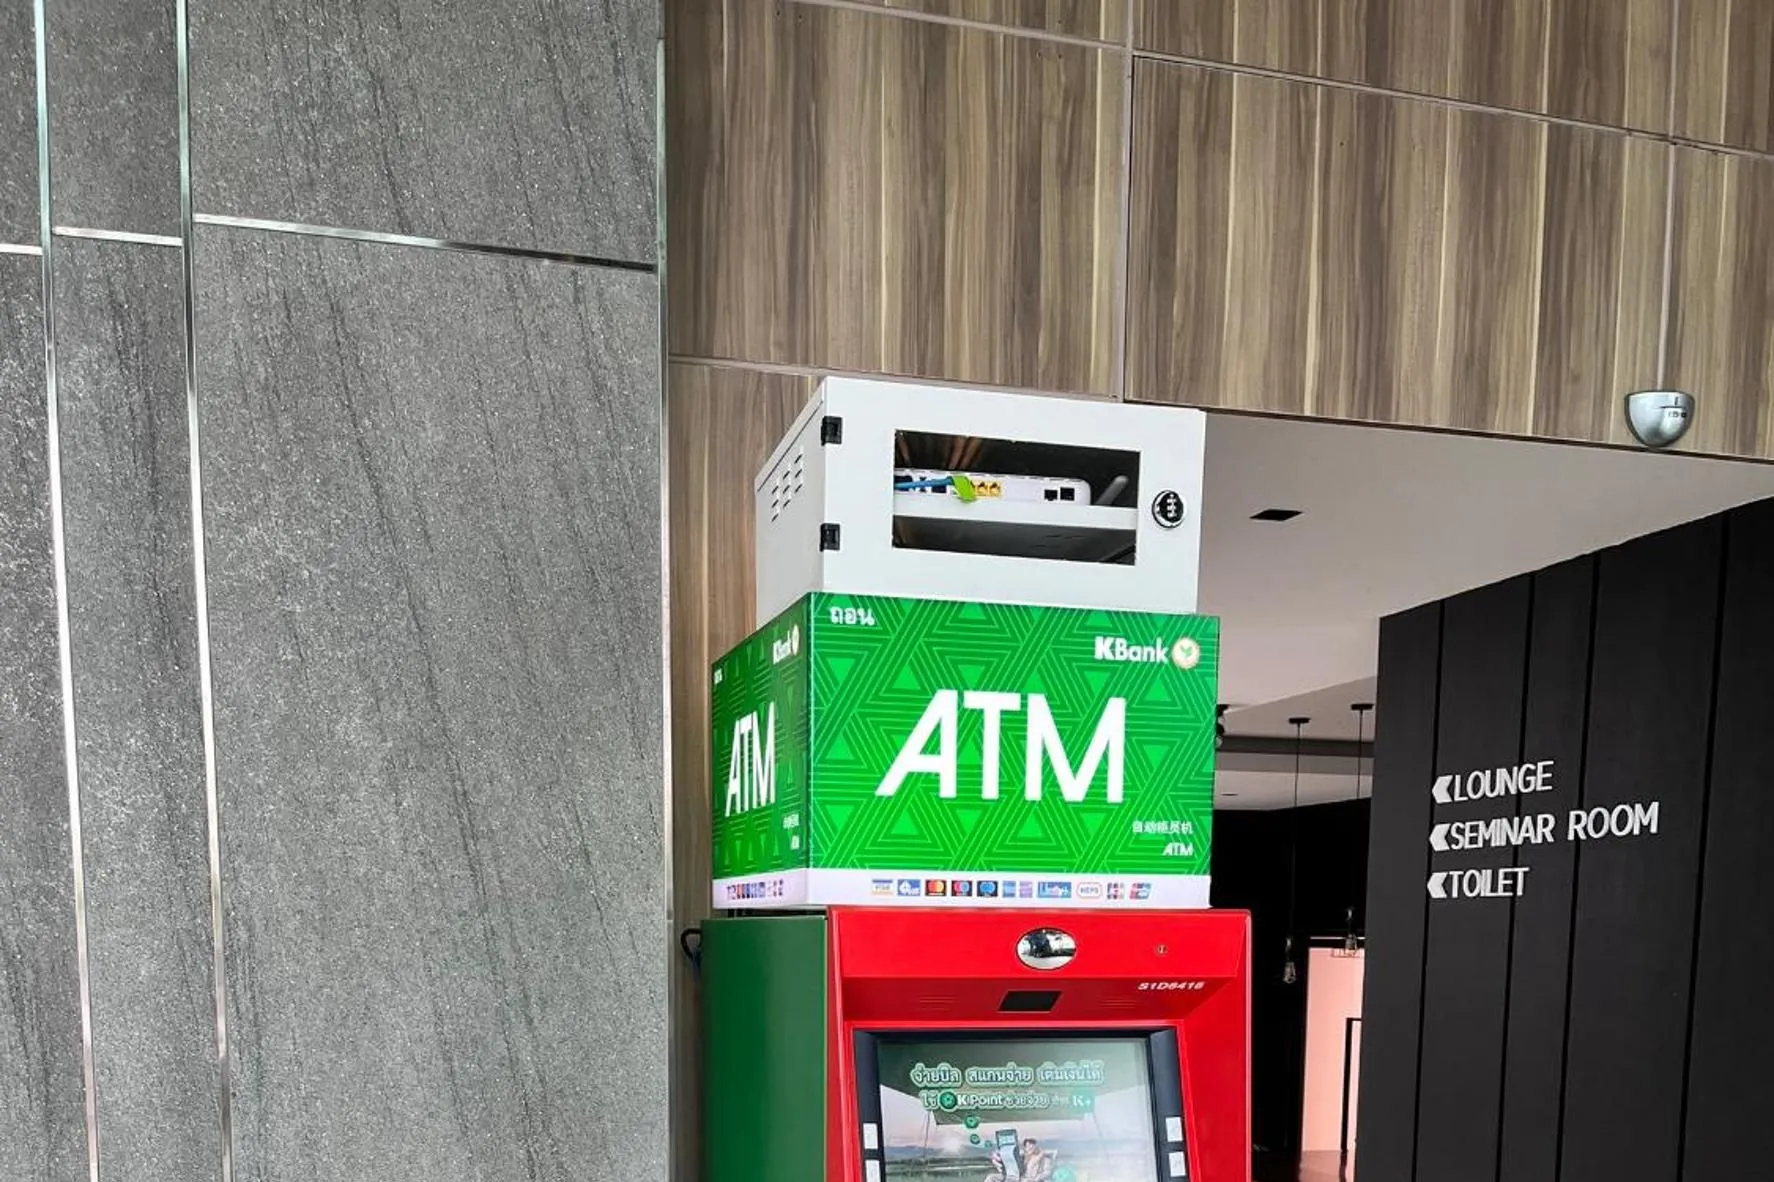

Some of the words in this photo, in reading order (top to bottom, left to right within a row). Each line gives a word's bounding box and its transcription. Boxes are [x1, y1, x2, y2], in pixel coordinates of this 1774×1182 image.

[831, 606, 875, 626] ถอน
[1094, 635, 1168, 664] KBank
[725, 701, 776, 817] ATM
[874, 688, 1127, 803] ATM
[1452, 761, 1554, 801] LOUNGE
[1450, 814, 1556, 850] SEMINAR
[1567, 802, 1660, 842] ROOM
[1162, 842, 1194, 856] ATM
[1449, 867, 1530, 898] TOILET
[970, 1093, 1003, 1107] Point
